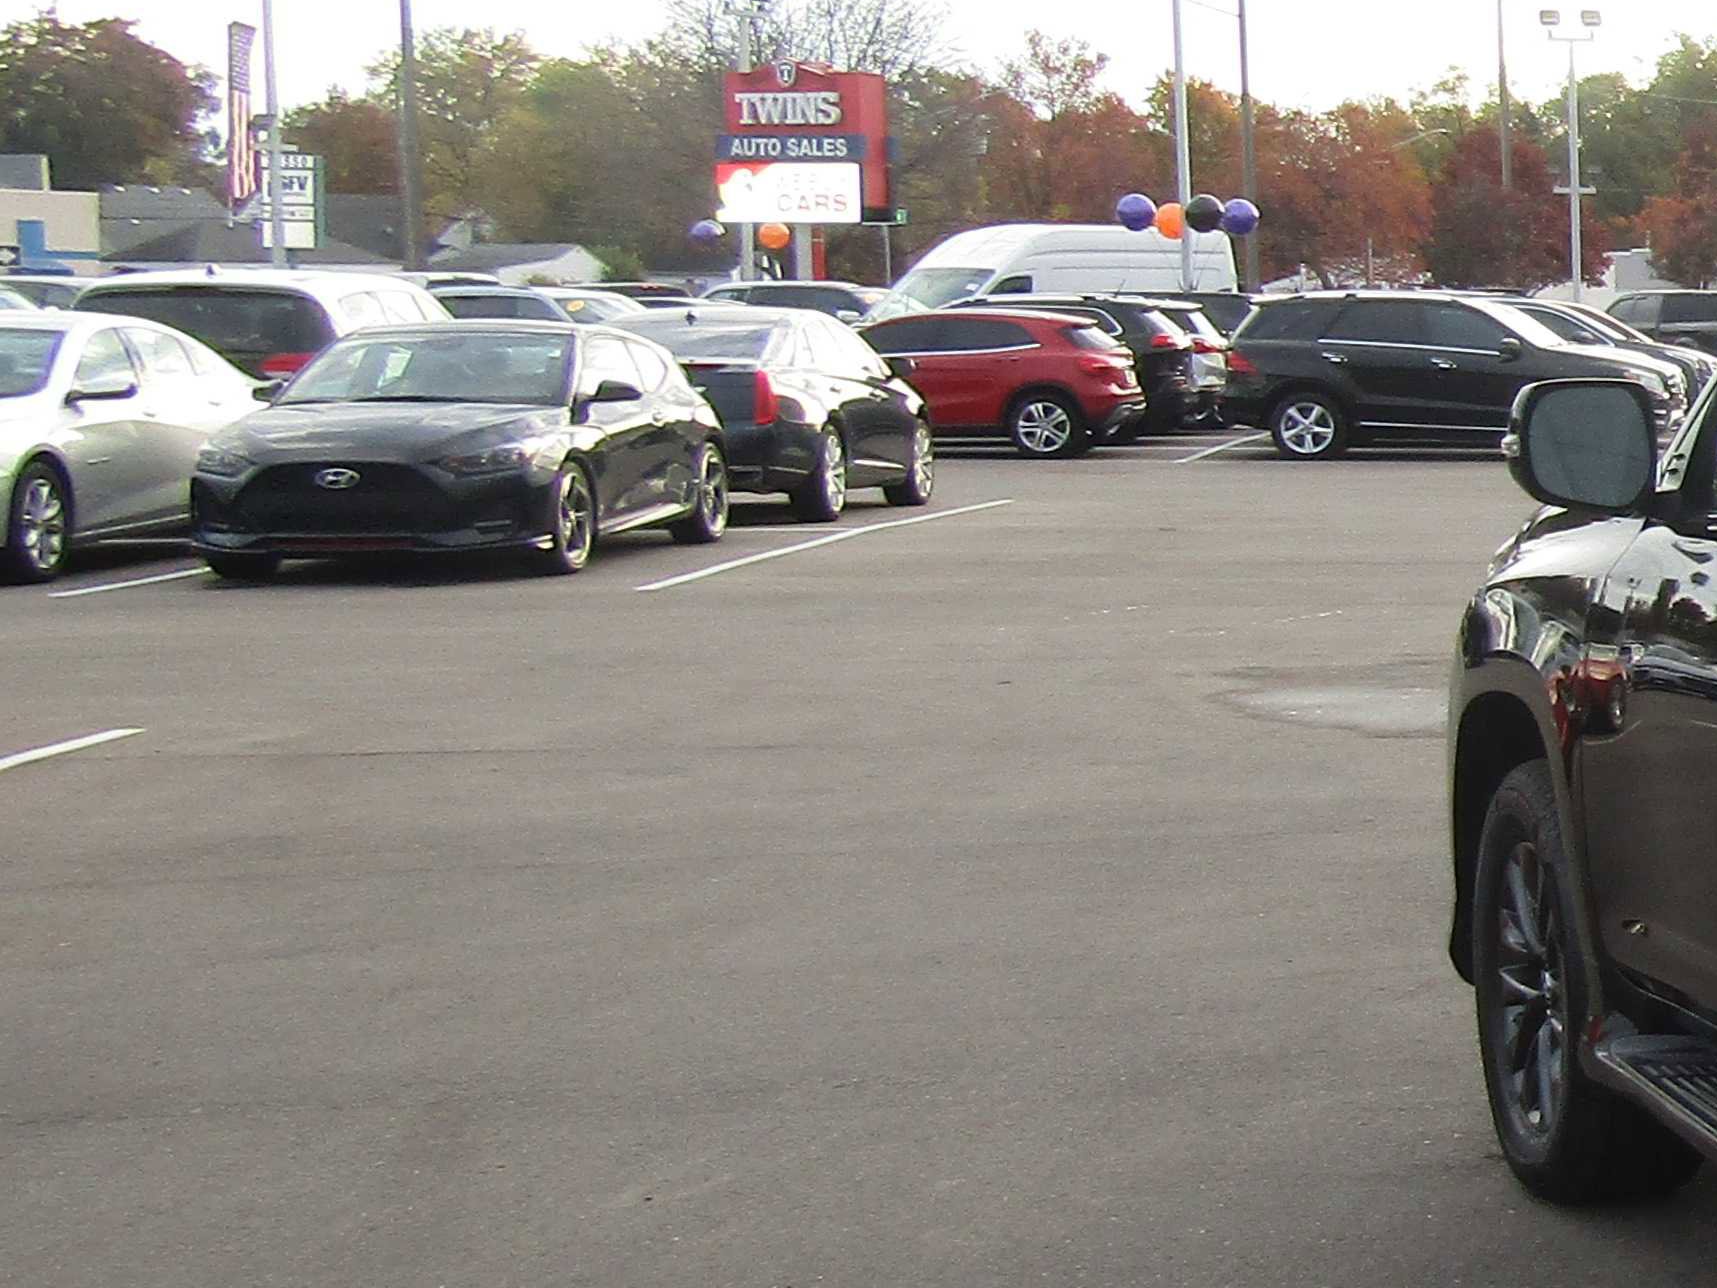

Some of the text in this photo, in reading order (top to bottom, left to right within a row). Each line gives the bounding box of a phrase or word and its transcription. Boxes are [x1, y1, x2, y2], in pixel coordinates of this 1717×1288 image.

[734, 91, 842, 125] TWINS
[730, 137, 848, 157] AUTO SALES
[776, 193, 848, 212] CARS
